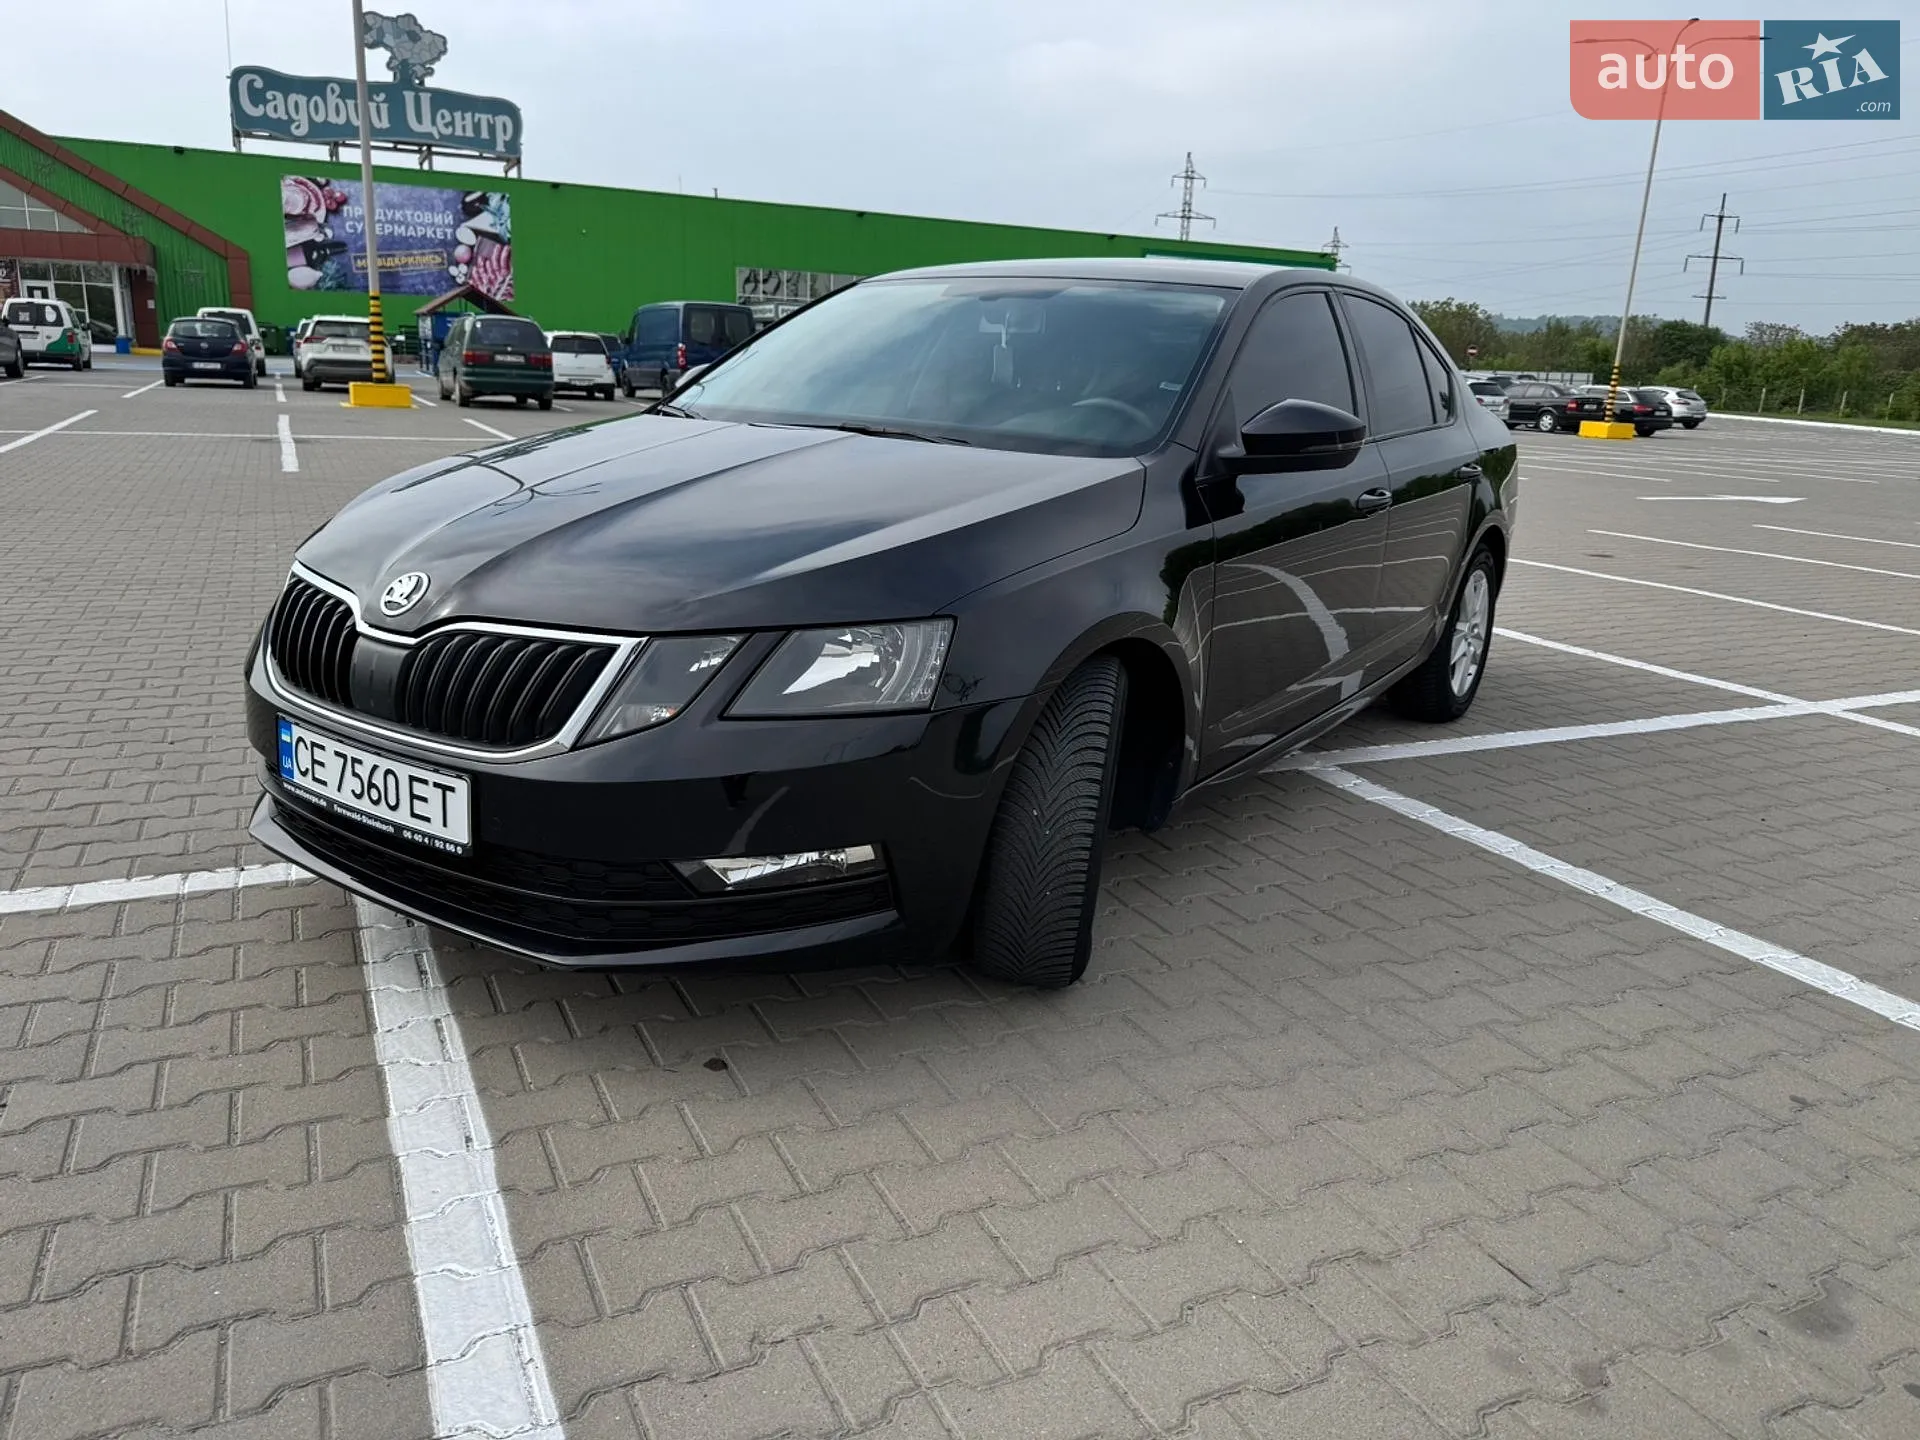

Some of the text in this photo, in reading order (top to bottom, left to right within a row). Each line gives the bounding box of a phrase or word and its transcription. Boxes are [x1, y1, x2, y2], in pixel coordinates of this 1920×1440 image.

[403, 89, 514, 153] Центр
[343, 205, 454, 226] ПРДУКТОВИЙ
[345, 220, 454, 240] СУЕРМАРКЕТ
[282, 756, 293, 770] UA
[334, 751, 401, 812] 7560
[409, 775, 455, 828] ET
